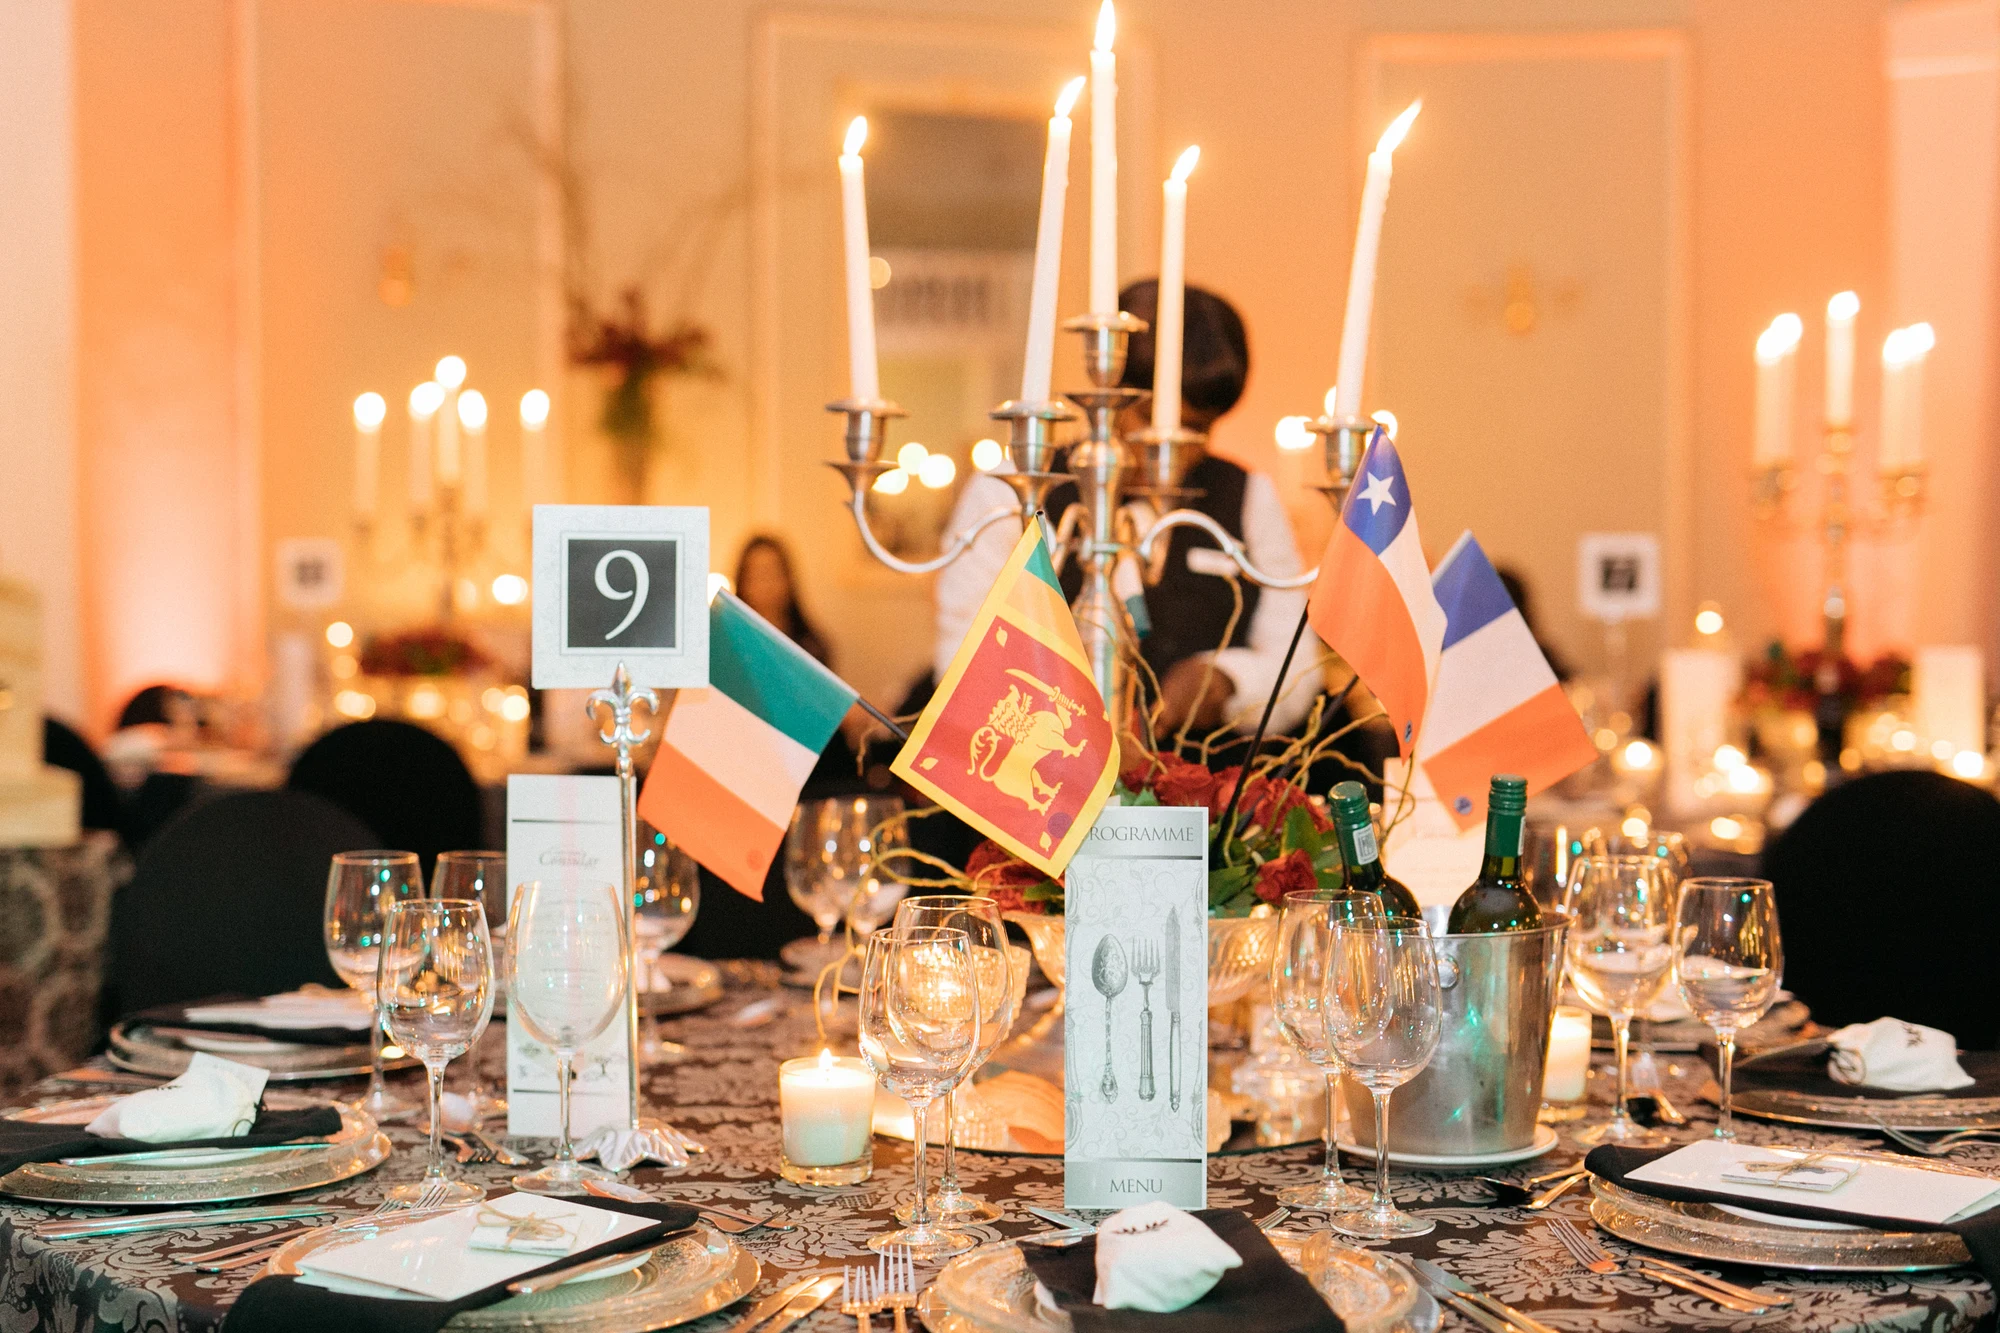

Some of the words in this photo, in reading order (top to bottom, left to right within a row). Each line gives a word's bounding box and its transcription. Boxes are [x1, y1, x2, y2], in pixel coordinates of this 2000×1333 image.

[594, 549, 650, 640] 9
[1089, 826, 1194, 841] ROGRAMME
[1109, 1178, 1163, 1194] MENU
